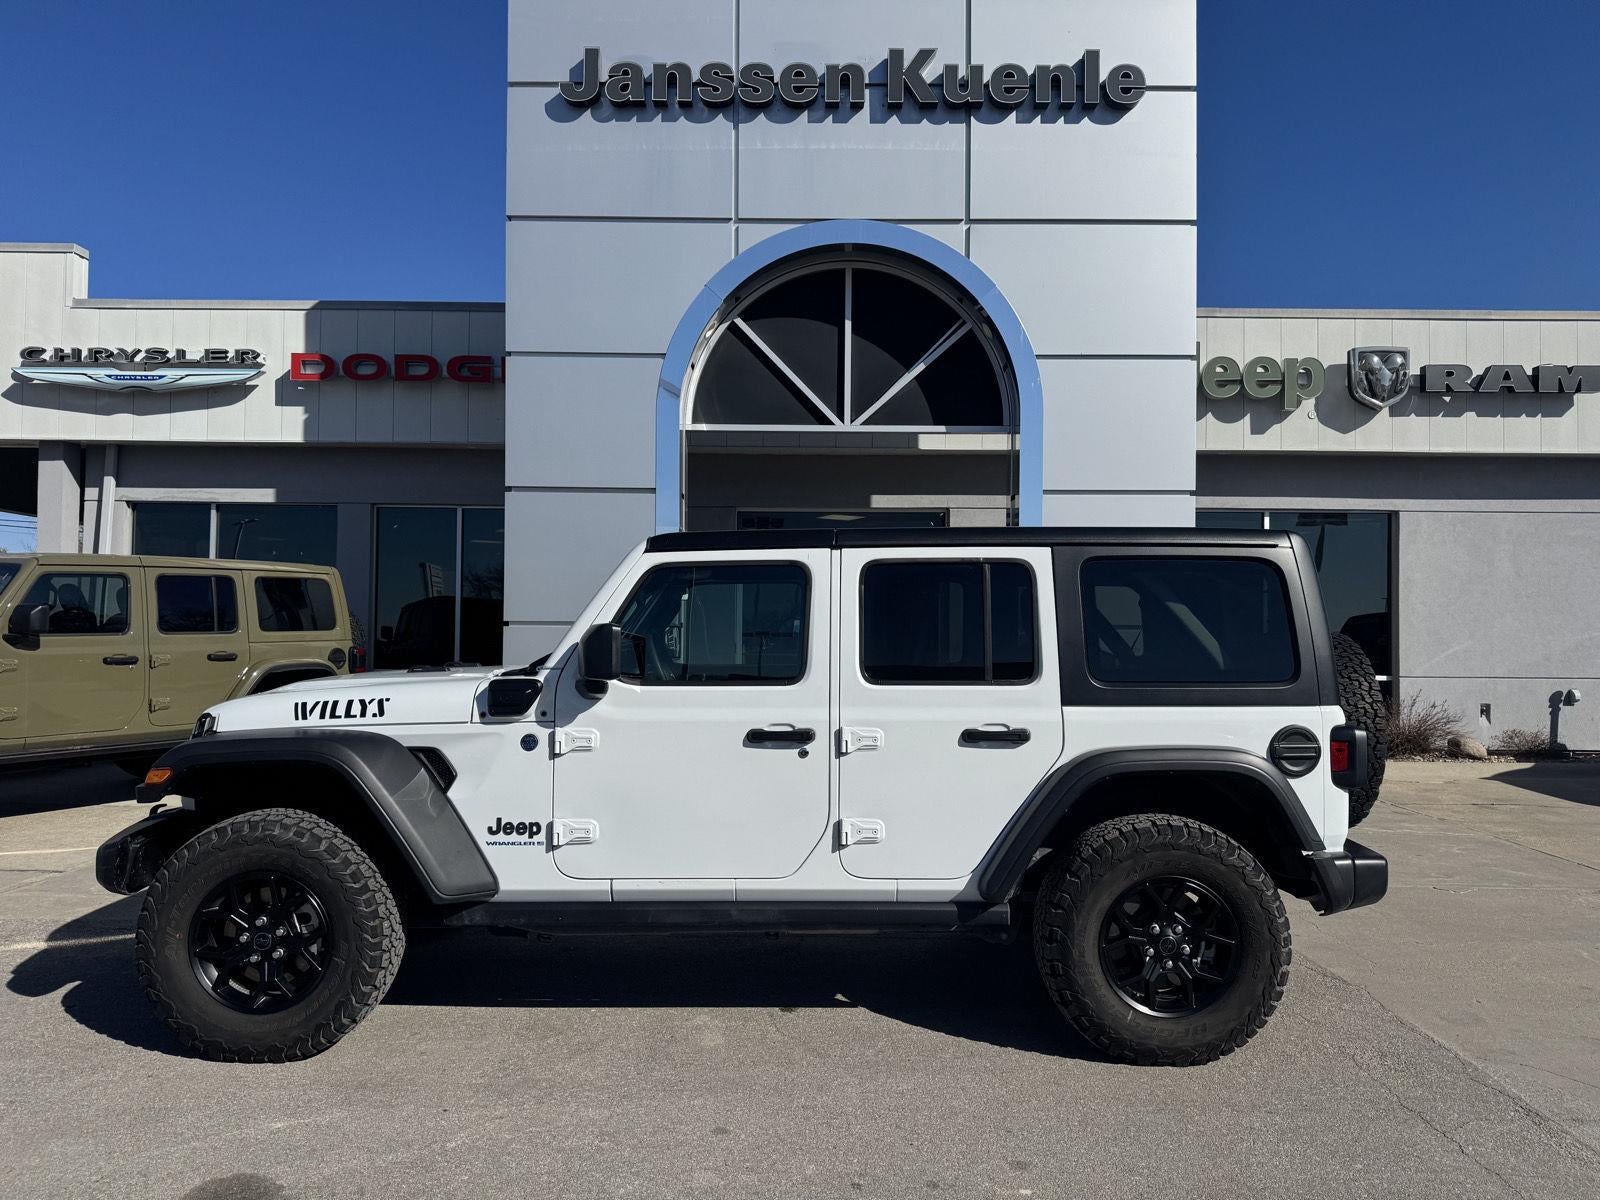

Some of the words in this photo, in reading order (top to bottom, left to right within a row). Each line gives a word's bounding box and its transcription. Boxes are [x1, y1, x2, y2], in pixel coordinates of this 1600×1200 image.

[559, 47, 866, 106] Janssen
[887, 48, 1147, 105] Kuenle
[20, 346, 263, 364] CHRYSLER
[290, 352, 506, 383] DODG
[1201, 355, 1326, 411] eep
[1421, 363, 1600, 393] RAM
[294, 697, 391, 721] WILLYS
[487, 817, 542, 839] Jeep
